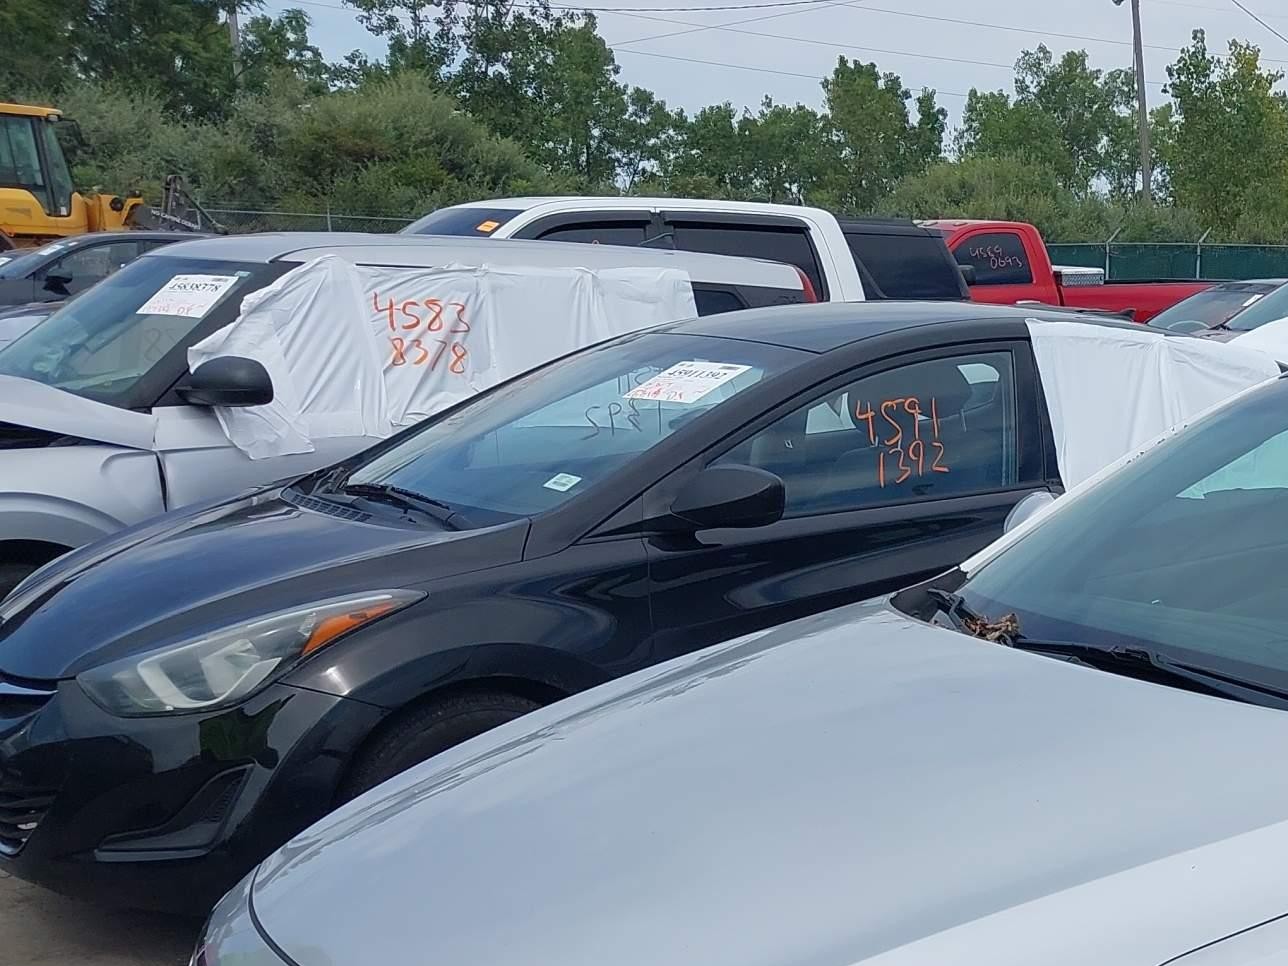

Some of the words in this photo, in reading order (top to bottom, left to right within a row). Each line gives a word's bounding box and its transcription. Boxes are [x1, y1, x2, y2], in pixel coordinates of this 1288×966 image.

[373, 291, 471, 332] 4583
[390, 337, 468, 374] 8378
[856, 397, 938, 446] 4591
[880, 440, 950, 488] 1392
